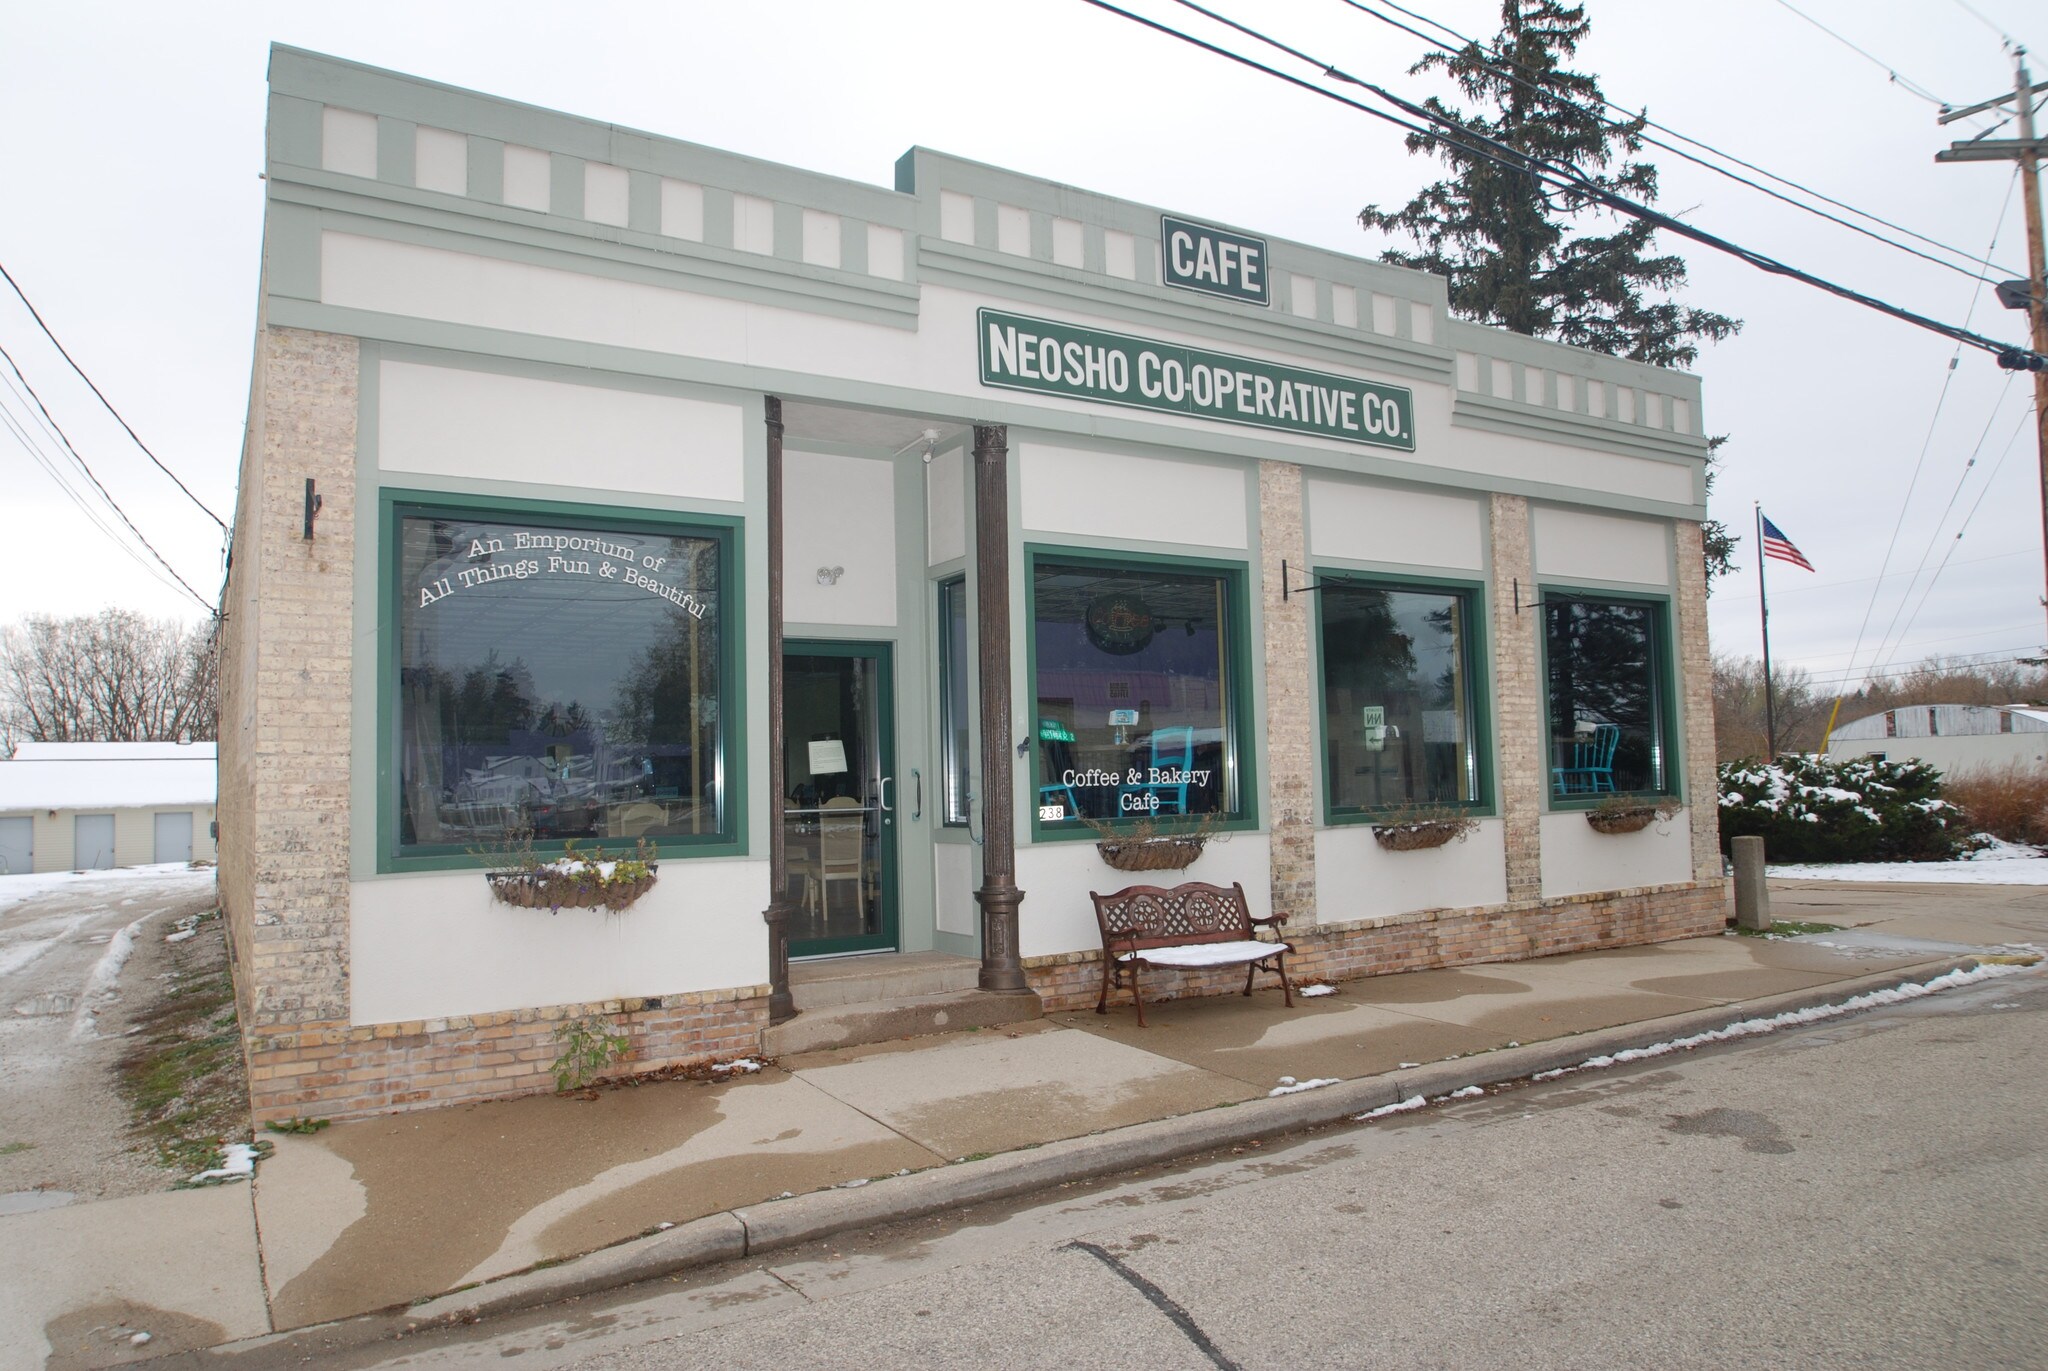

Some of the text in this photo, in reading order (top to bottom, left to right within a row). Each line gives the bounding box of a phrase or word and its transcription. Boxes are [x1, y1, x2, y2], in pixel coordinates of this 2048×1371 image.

[1171, 230, 1262, 293] CAFE
[988, 323, 1409, 440] NEOSHO CO-OPERATIVE CO.
[467, 532, 666, 573] An Emporium of
[419, 556, 707, 620] All Things Fun & Beautiful
[1062, 767, 1211, 787] Coffee & Bakery
[1040, 807, 1062, 819] 238
[1120, 792, 1160, 811] Cafe
